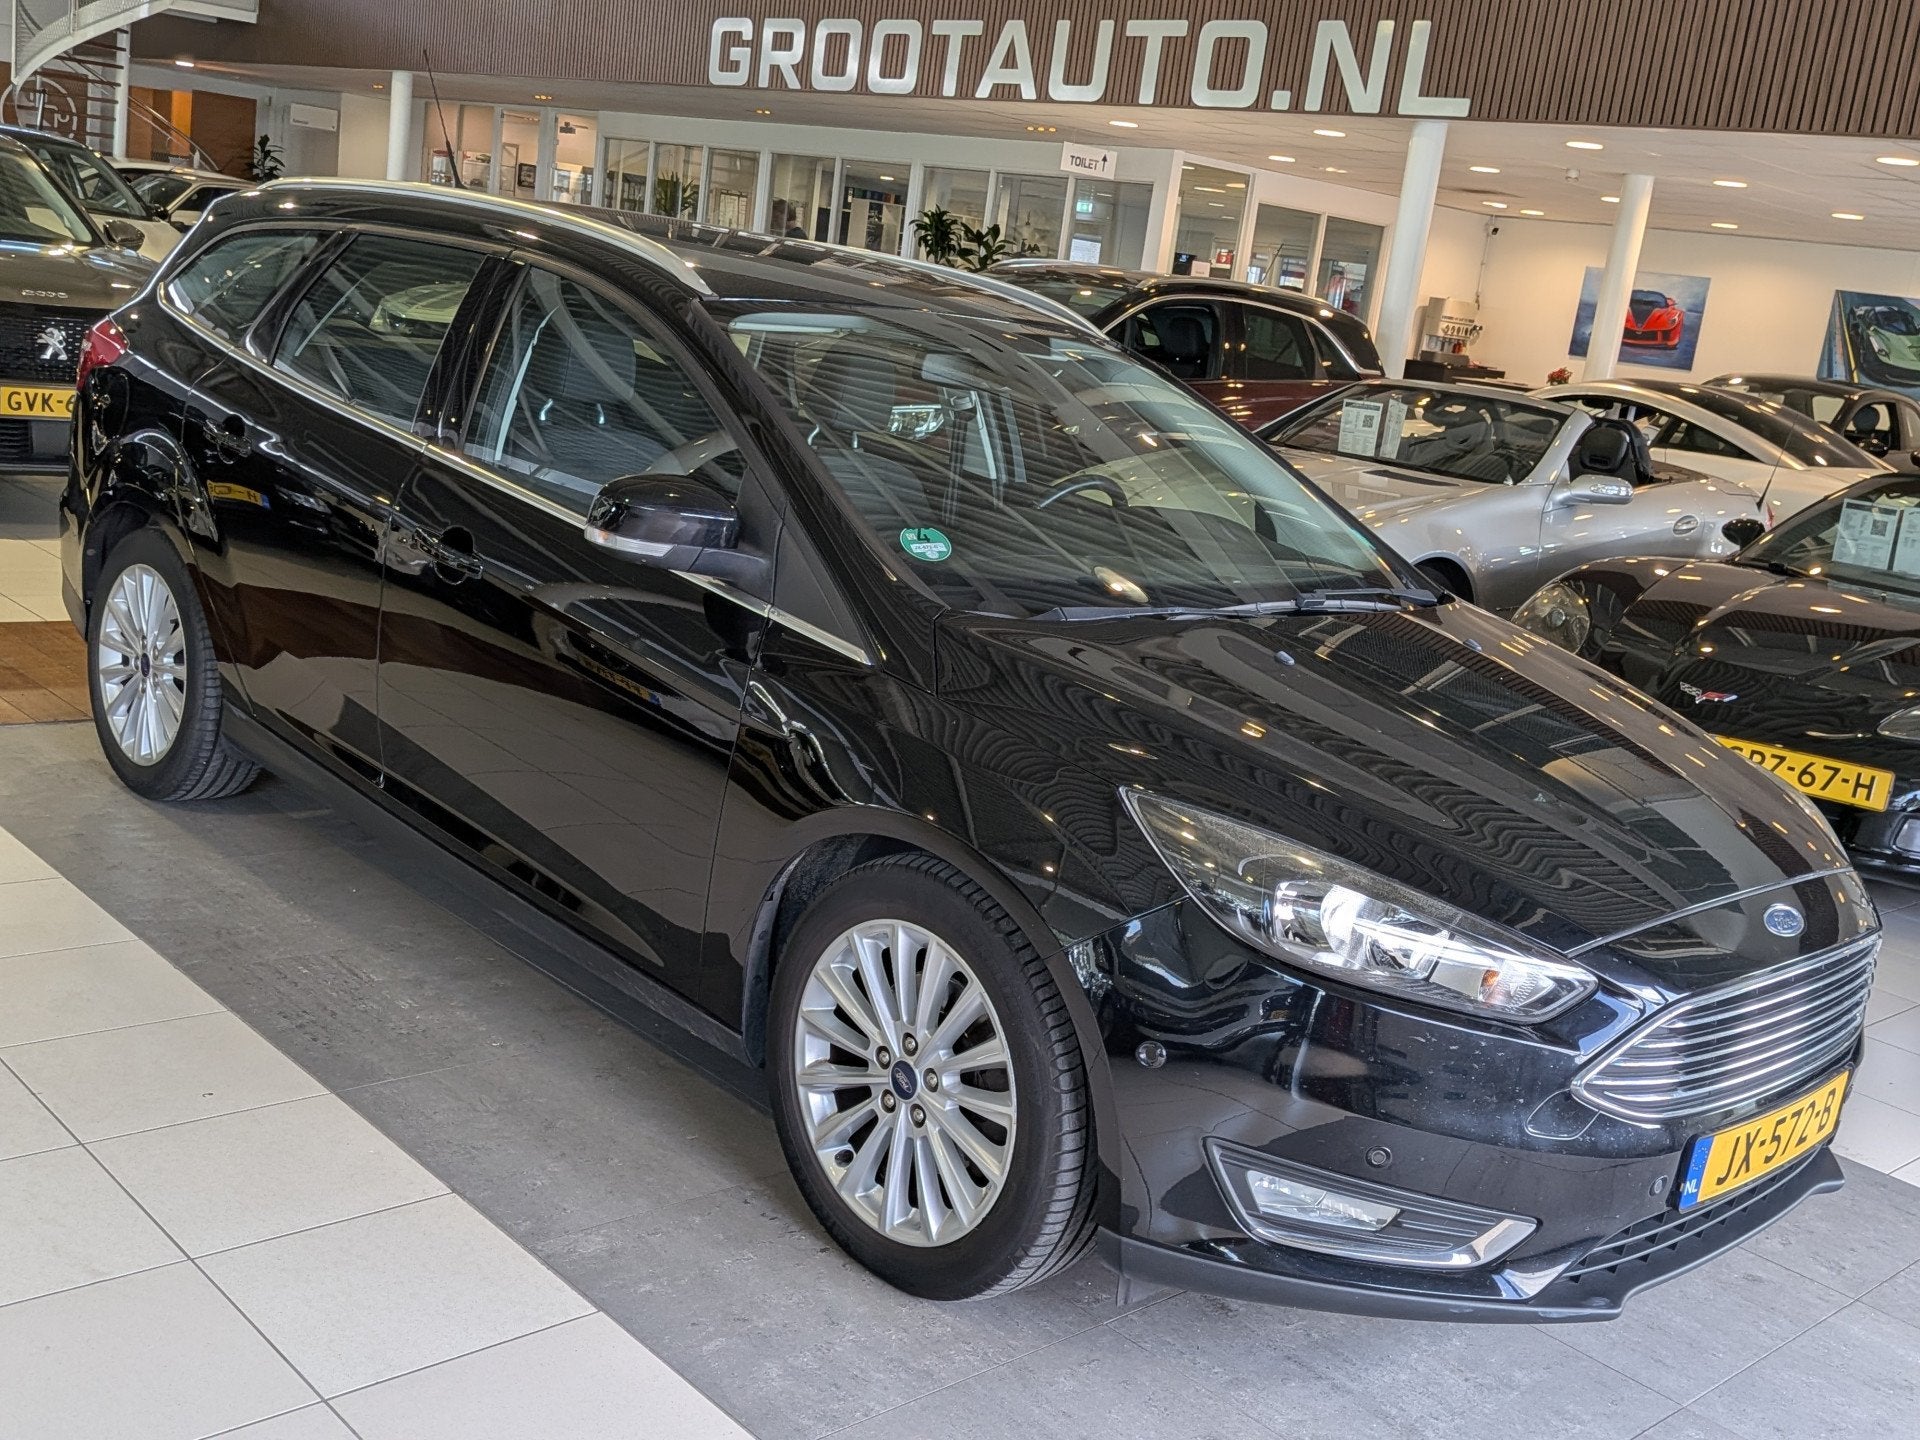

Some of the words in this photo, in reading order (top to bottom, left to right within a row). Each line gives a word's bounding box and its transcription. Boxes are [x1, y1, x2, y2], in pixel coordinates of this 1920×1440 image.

[709, 17, 1471, 117] GROOTAUTO.NL
[1070, 155, 1099, 170] TOILET
[1728, 746, 1876, 802] Z-67-H
[1716, 1087, 1837, 1186] JX-572-B
[1684, 1179, 1698, 1196] NL
